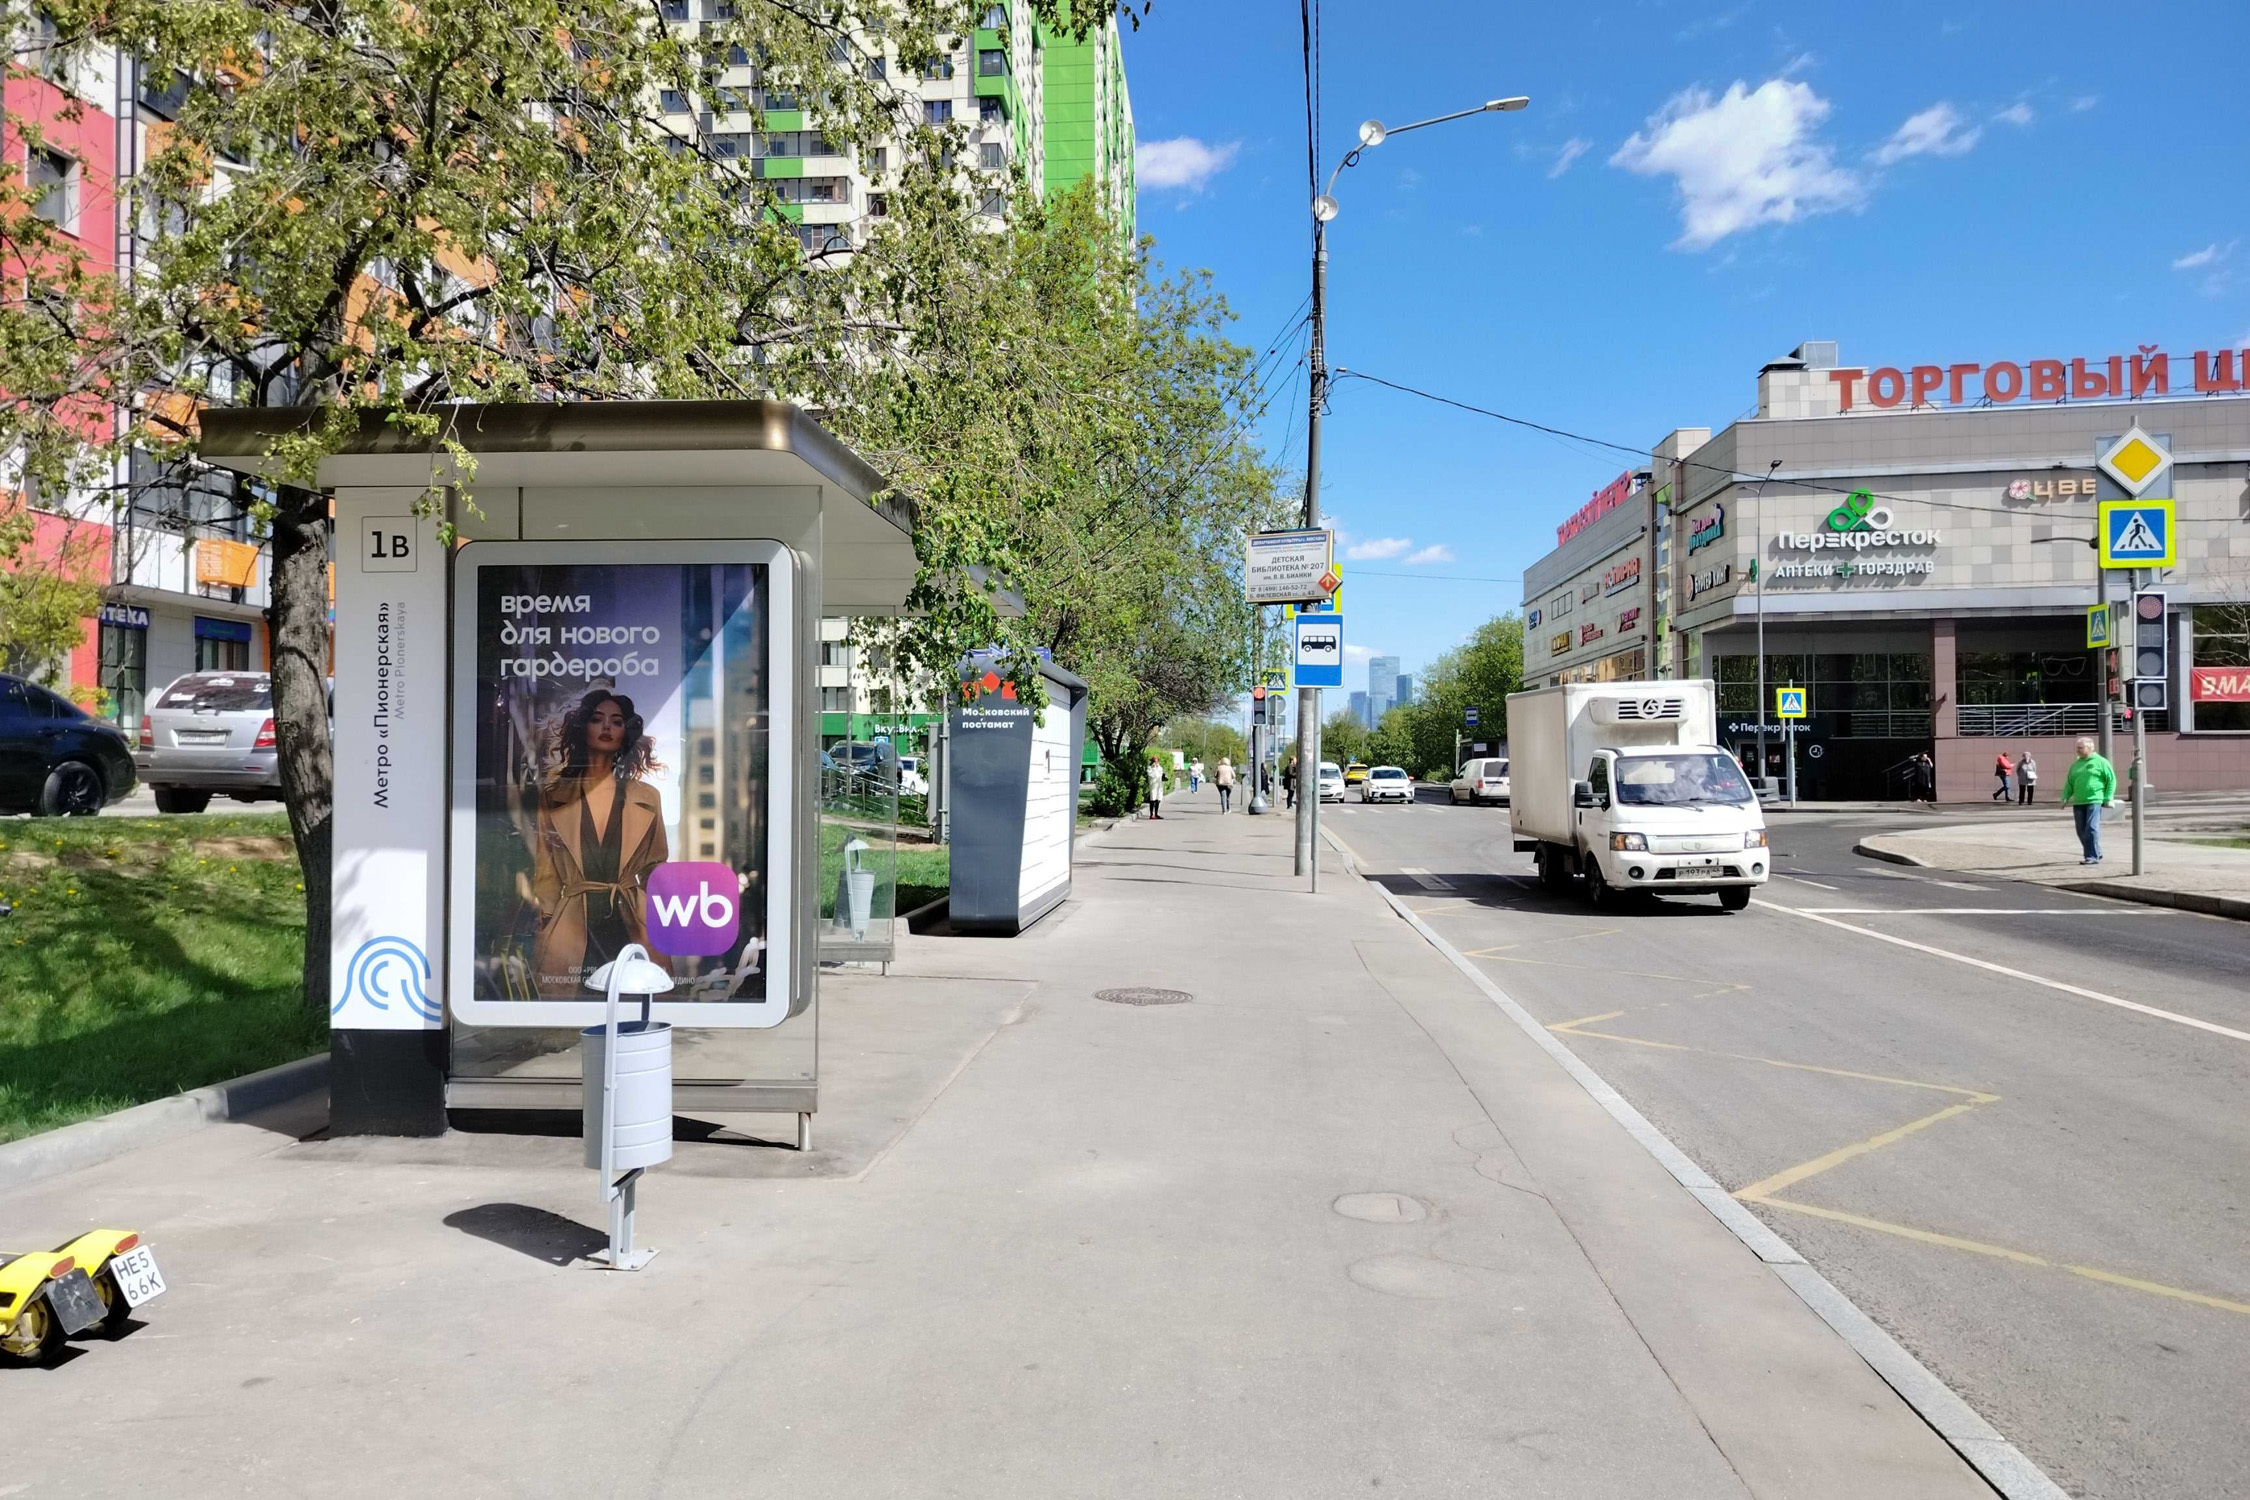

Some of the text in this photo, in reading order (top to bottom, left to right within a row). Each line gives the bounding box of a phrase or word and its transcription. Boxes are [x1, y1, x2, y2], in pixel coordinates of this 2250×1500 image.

[1829, 344, 2250, 410] ТОРГОВЫЙ Ц
[1778, 529, 1943, 553] Перекресток
[1251, 564, 1301, 574] БИБЛИОТЕКА
[1310, 562, 1324, 570] 207
[1271, 555, 1305, 564] ДЕТСКАЯ
[1775, 560, 1935, 578] АПТЕКИ ГОРЗДРАВ
[501, 594, 591, 619] время
[500, 619, 661, 645] для нового
[394, 602, 408, 720] Metro Pionerskaya
[500, 651, 659, 683] гардероба
[373, 602, 392, 809] Метро «Пионерская»
[962, 720, 1015, 729] постамат
[1740, 723, 1811, 734] Перекрсток
[651, 880, 734, 929] wb
[541, 976, 581, 985] МОСКОВСКАЯ
